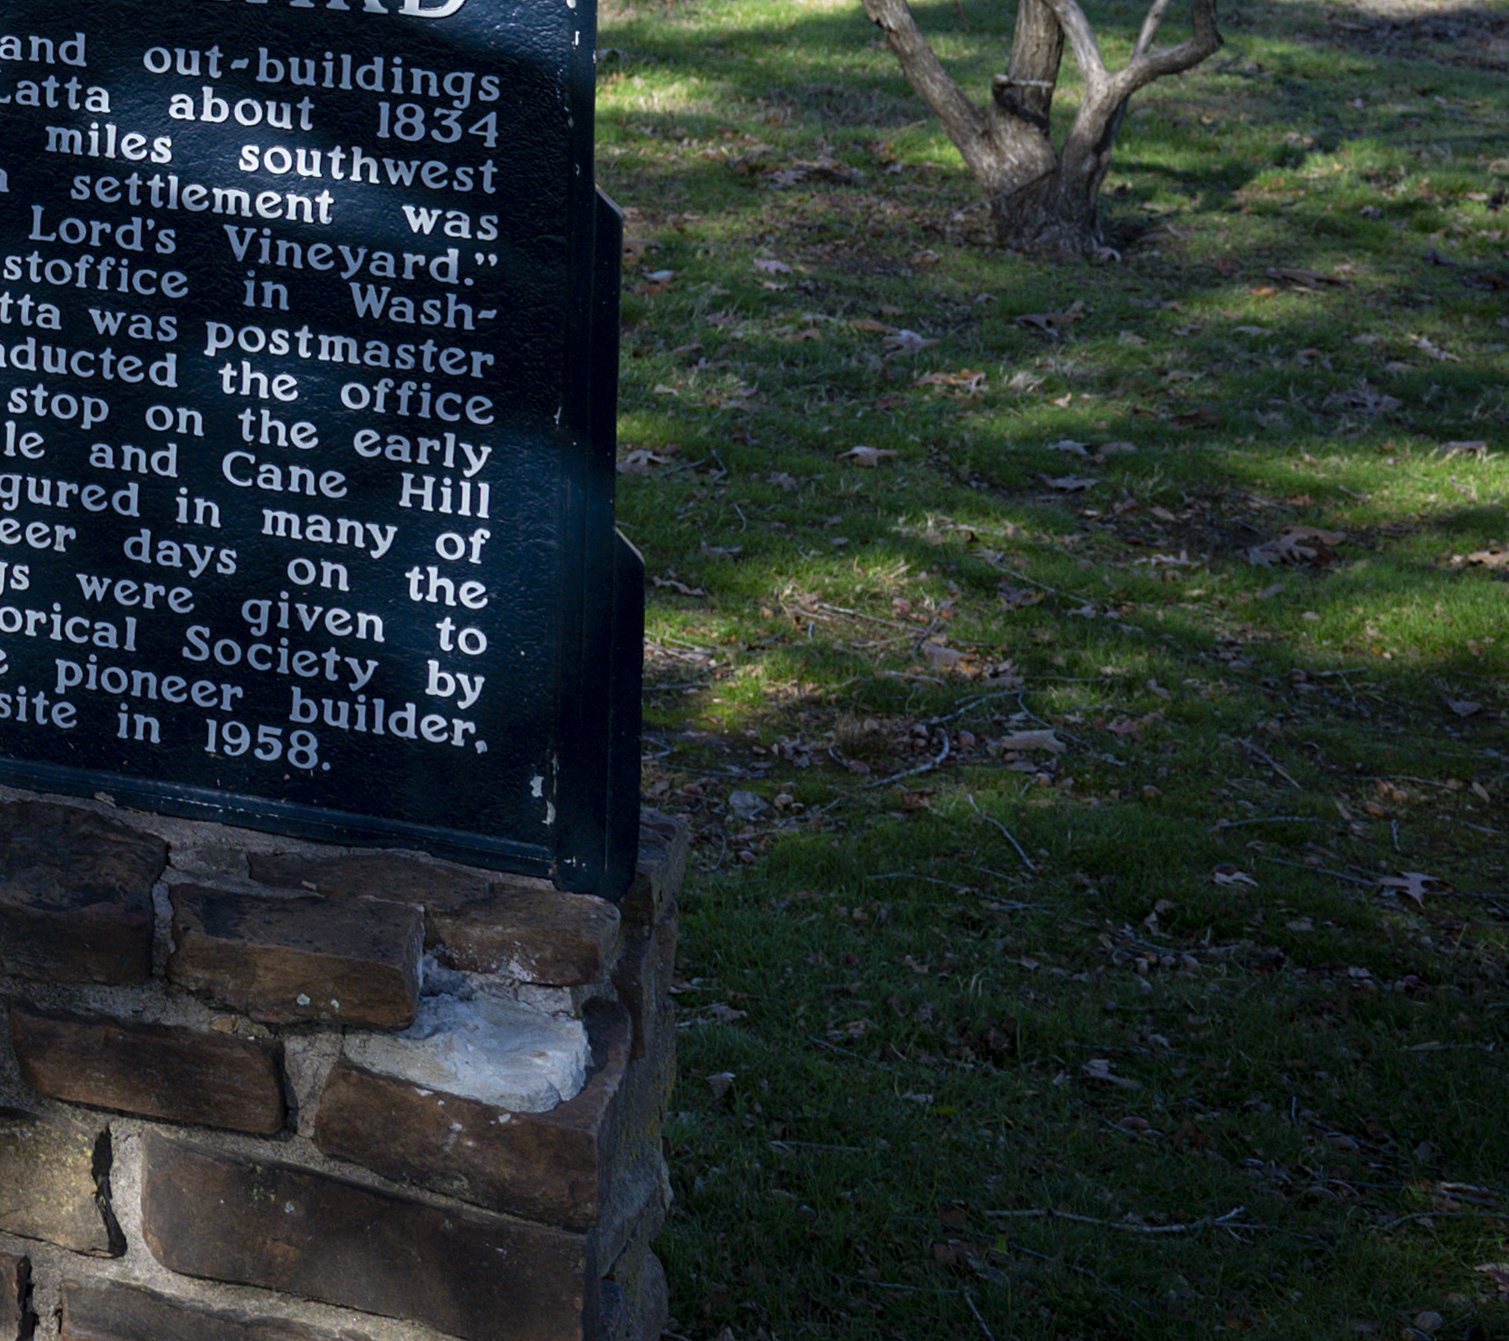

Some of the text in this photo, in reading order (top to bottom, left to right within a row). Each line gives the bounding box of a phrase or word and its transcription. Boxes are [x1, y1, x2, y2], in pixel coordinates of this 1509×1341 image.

[143, 45, 500, 109] out-buildings
[168, 85, 315, 131] about
[376, 101, 499, 148] 1834
[45, 121, 172, 164] miles
[238, 144, 498, 194] southwest
[70, 172, 335, 225] settlement
[401, 203, 498, 241] was
[28, 205, 176, 254] Lord's
[223, 224, 498, 286] Vineyard."
[243, 270, 290, 311] in
[349, 282, 497, 330] Wash-
[88, 308, 178, 342] was
[203, 321, 494, 378] postmaster
[217, 360, 299, 402] the
[340, 377, 495, 425] office
[7, 383, 109, 430] stop
[145, 405, 205, 437] on
[237, 407, 319, 450] the
[353, 428, 493, 478] early
[89, 442, 179, 478] and
[222, 450, 348, 499] Cane
[398, 472, 490, 519] Hill
[175, 486, 222, 529] in
[261, 508, 399, 560] many
[435, 527, 491, 565] of
[123, 528, 238, 579] days
[287, 557, 350, 592] on
[404, 565, 489, 610] the
[75, 573, 195, 614] were
[241, 590, 386, 643] given
[435, 616, 488, 656] to
[54, 653, 243, 712] pioneer
[289, 686, 488, 754] builder,
[182, 625, 379, 692] Society
[424, 659, 486, 710] by
[117, 702, 161, 744] in
[204, 718, 331, 771] 1958.
